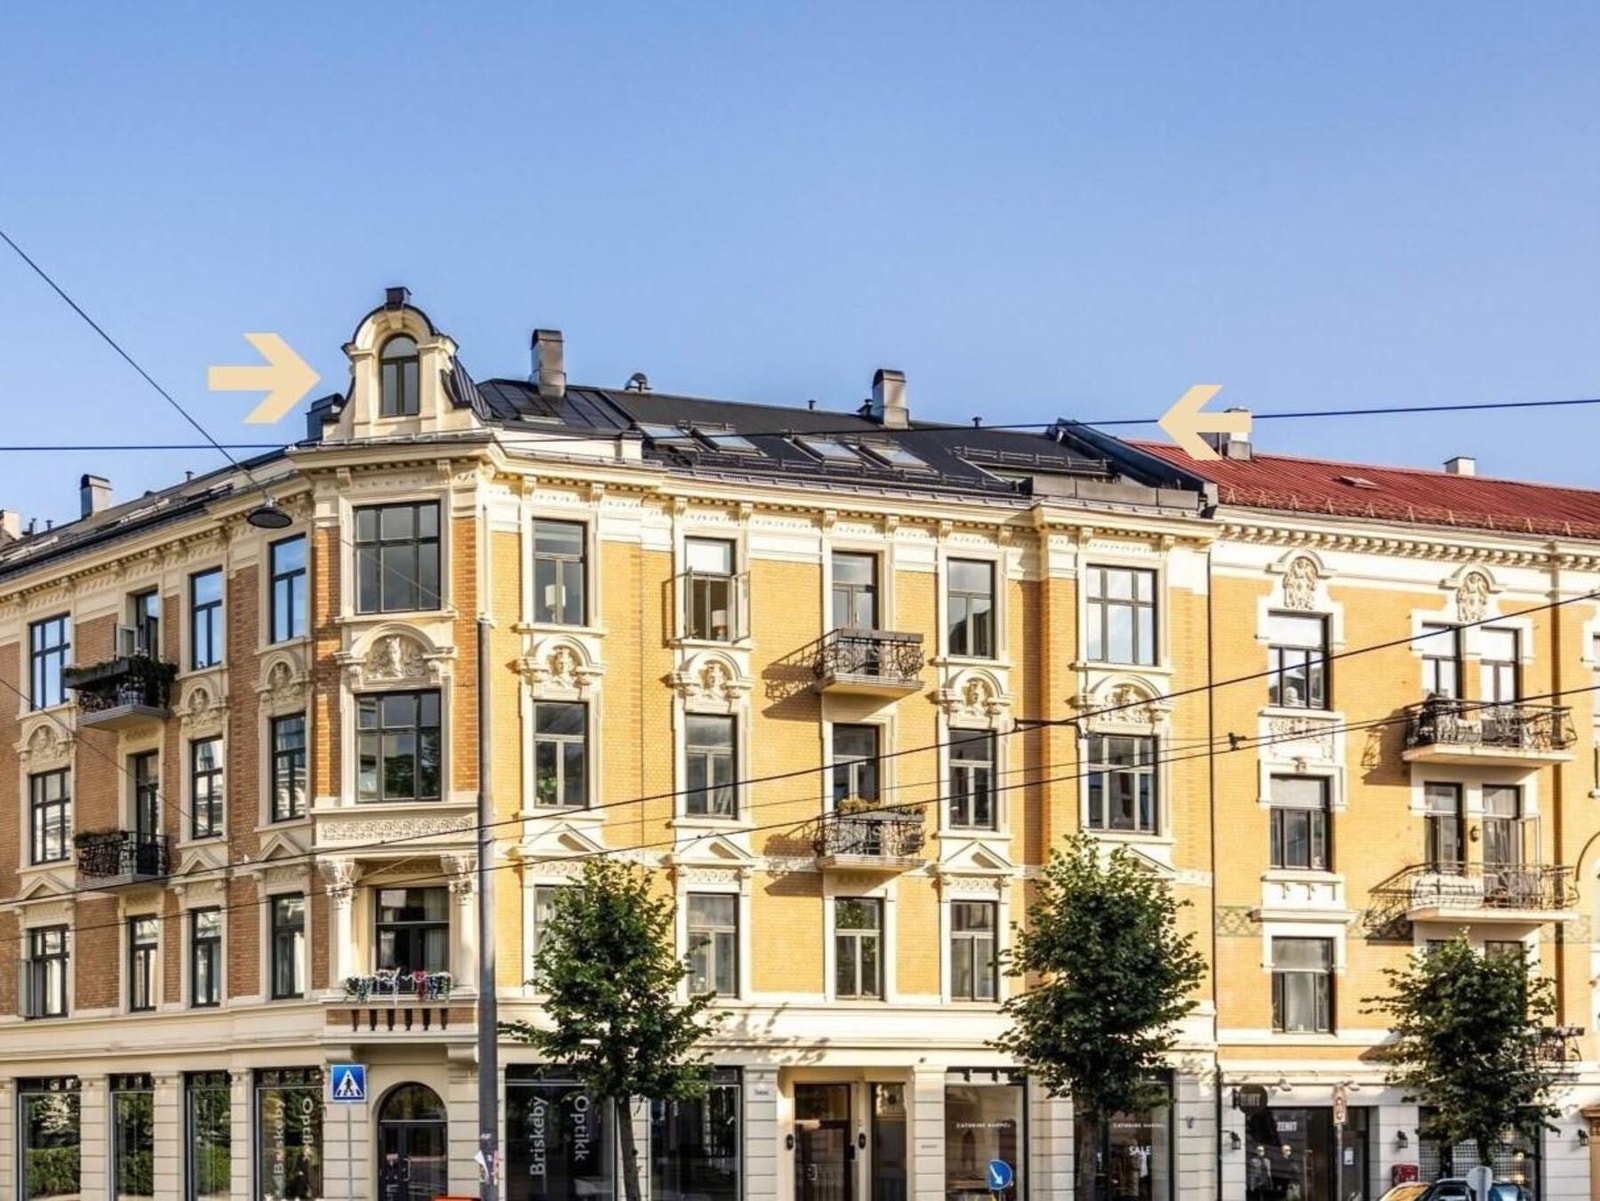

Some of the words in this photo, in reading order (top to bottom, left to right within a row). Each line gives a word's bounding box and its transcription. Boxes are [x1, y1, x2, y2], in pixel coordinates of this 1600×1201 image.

[529, 1096, 549, 1175] Briskeby
[570, 1095, 590, 1161] Optikk
[1129, 1145, 1152, 1156] SALE
